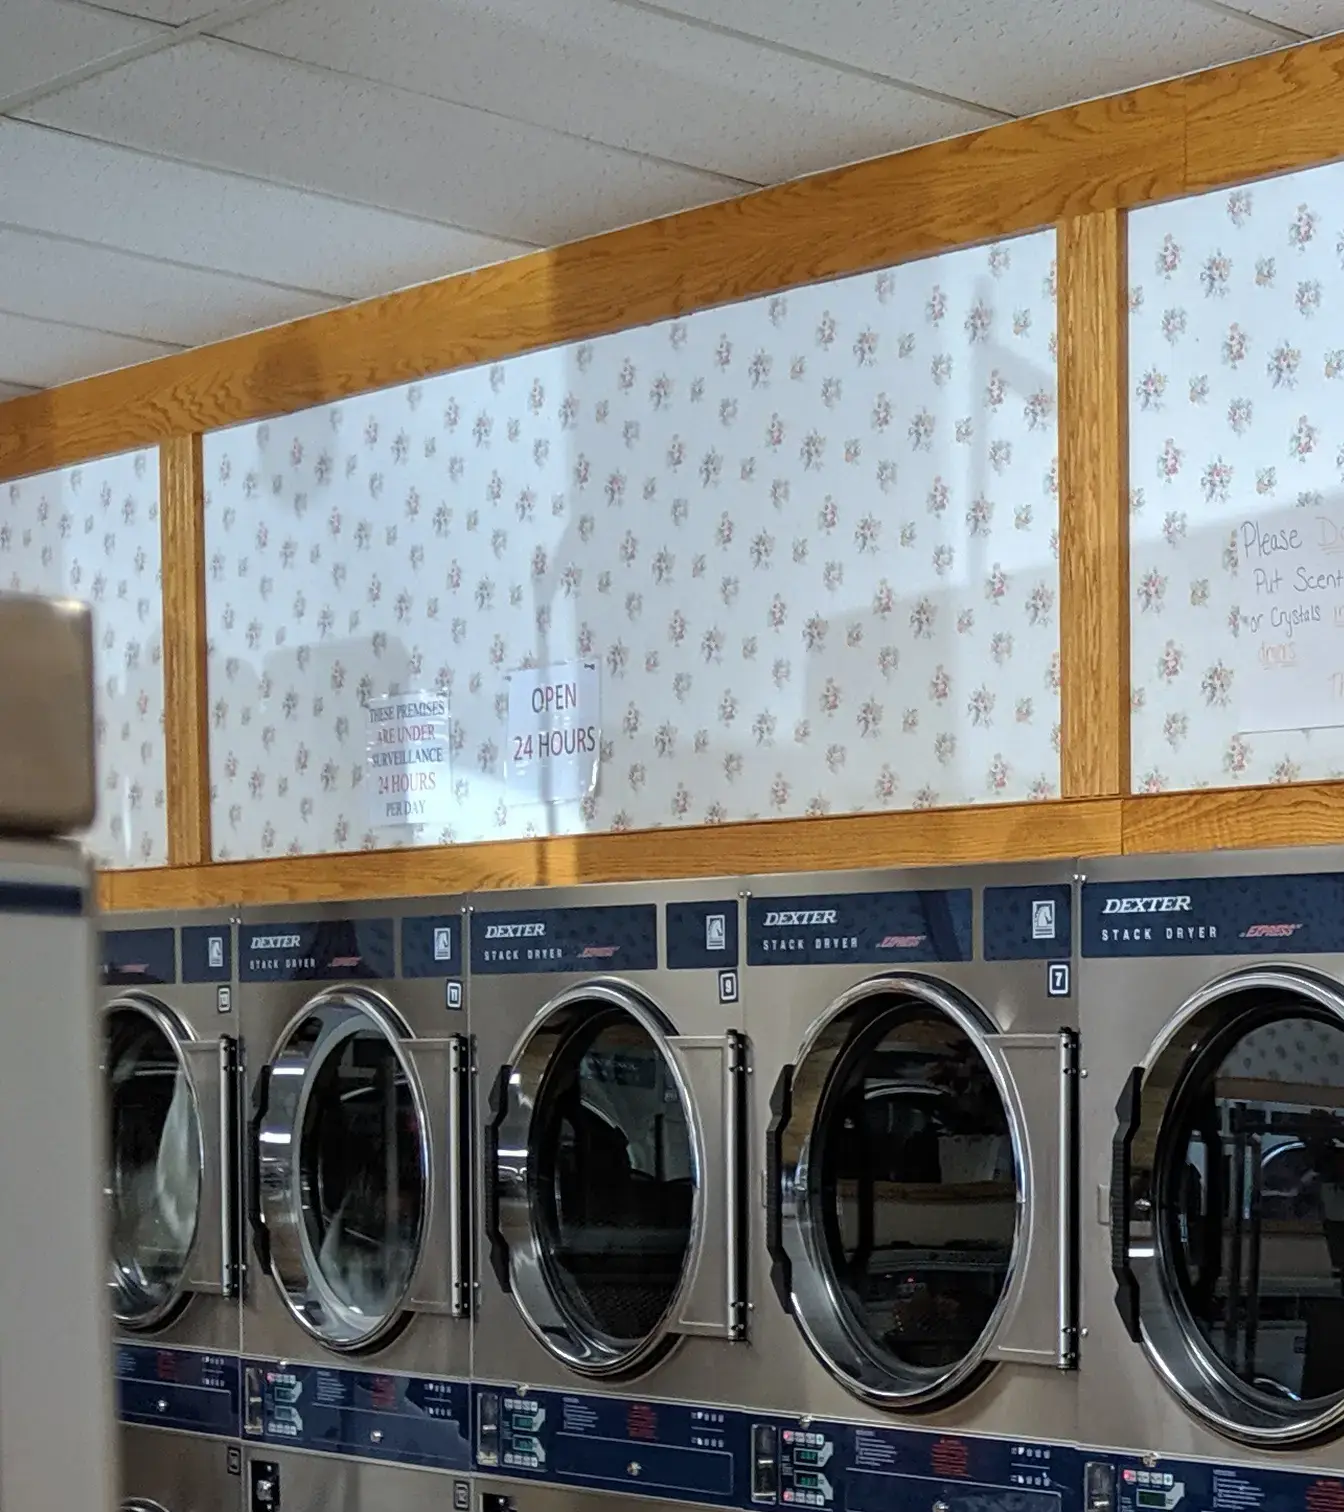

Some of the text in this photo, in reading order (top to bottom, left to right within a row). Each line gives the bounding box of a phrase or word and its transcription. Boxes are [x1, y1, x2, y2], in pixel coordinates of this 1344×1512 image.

[1241, 521, 1303, 557] Please
[1253, 568, 1283, 595] Put
[1293, 566, 1344, 592] Scent
[1250, 612, 1264, 634] or
[1271, 605, 1321, 638] Crystals
[532, 682, 577, 714] OPEN
[513, 726, 596, 761] 24 HOURS
[371, 747, 444, 769] SURVEILLANCE
[391, 772, 436, 792] HOURS
[1102, 895, 1191, 915] DEXTER
[763, 909, 838, 926] DEXTER
[485, 923, 546, 938] DEXTER
[1102, 924, 1218, 941] STACK DRYER
[251, 935, 301, 949] DEXTER
[763, 936, 858, 950] STACK DRYER
[725, 979, 733, 994] 9
[1055, 971, 1063, 987] 7
